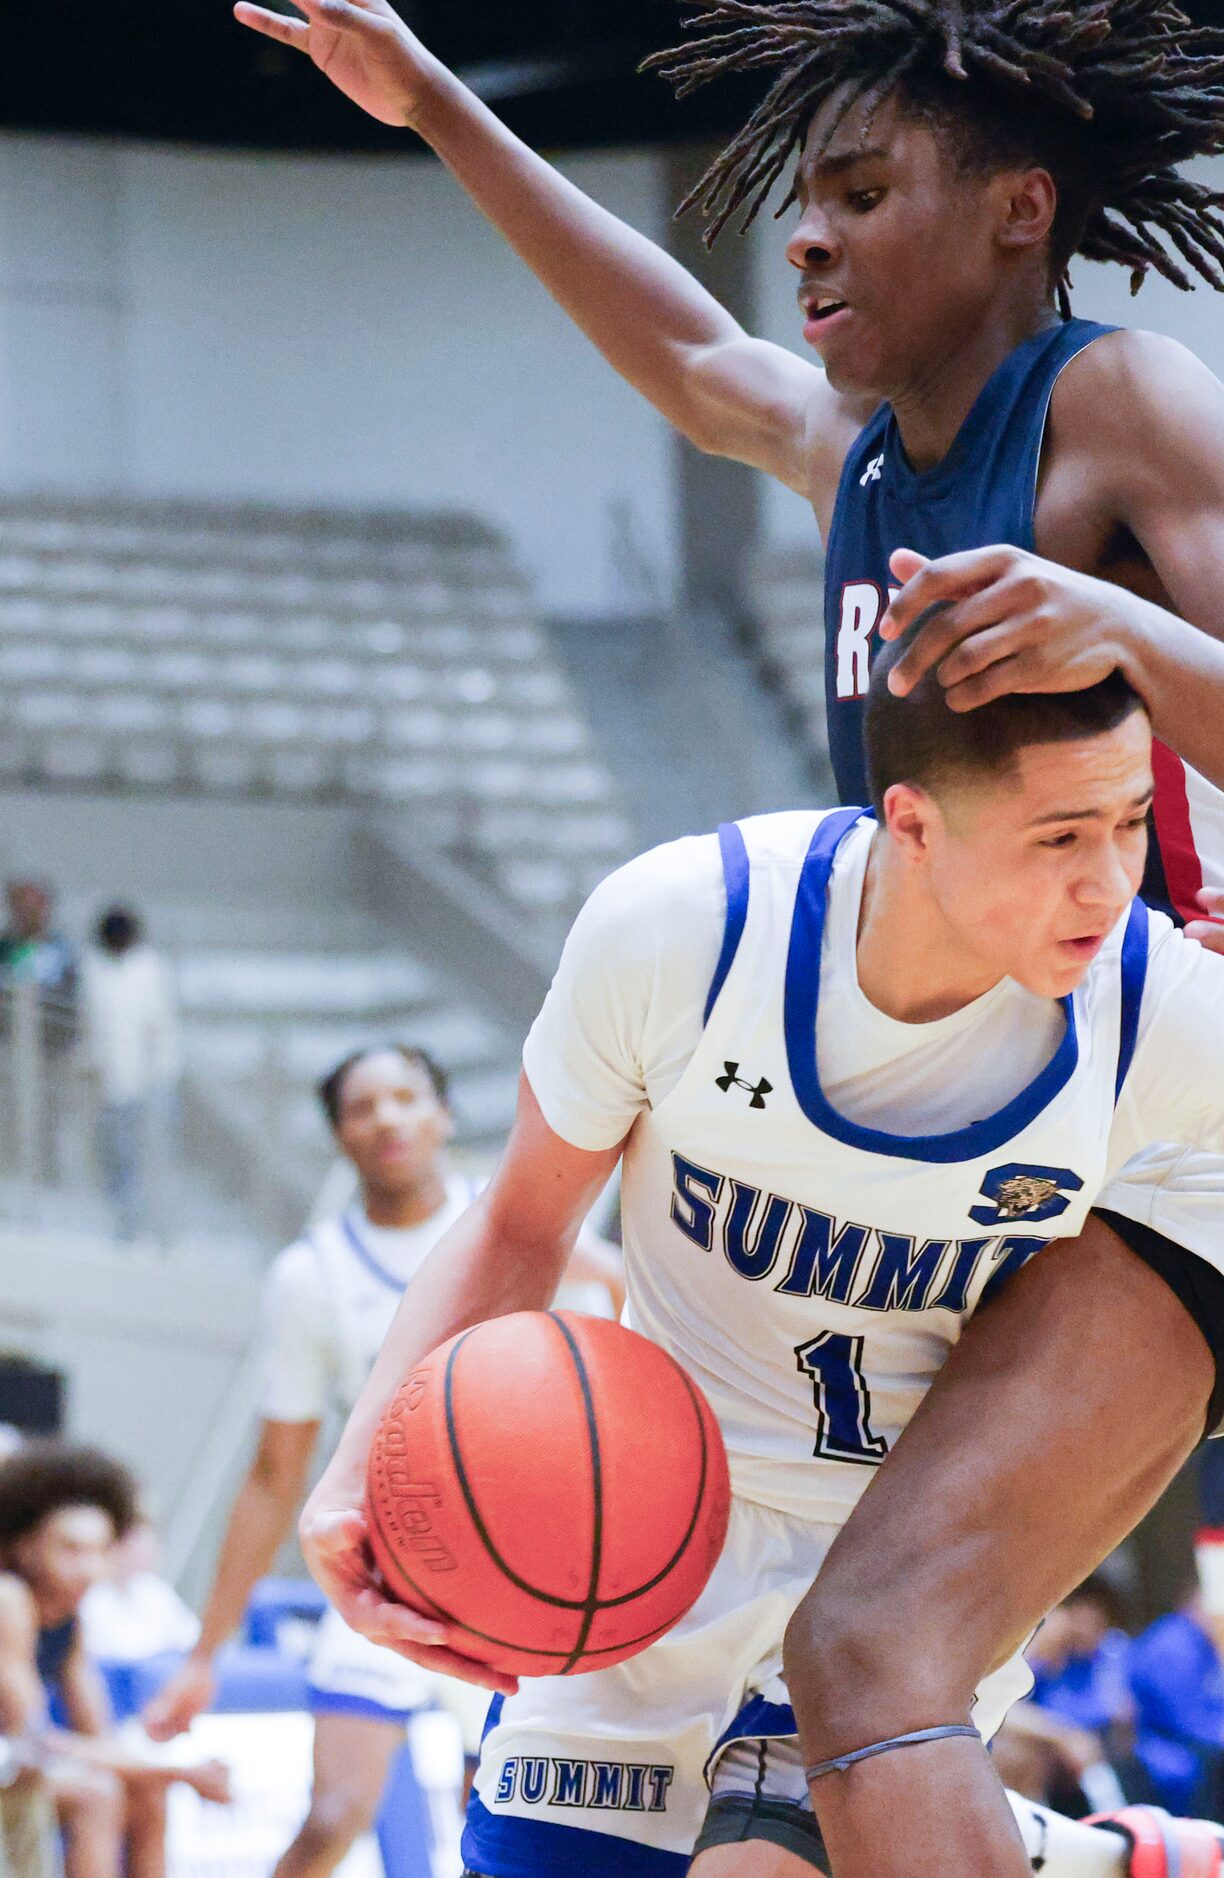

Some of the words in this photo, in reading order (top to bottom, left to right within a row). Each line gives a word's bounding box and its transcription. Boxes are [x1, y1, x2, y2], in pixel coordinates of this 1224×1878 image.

[670, 1149, 1058, 1312] SUMMIT
[381, 1367, 459, 1574] Baden
[794, 1330, 889, 1466] 1
[495, 1756, 675, 1812] SUMMIT
